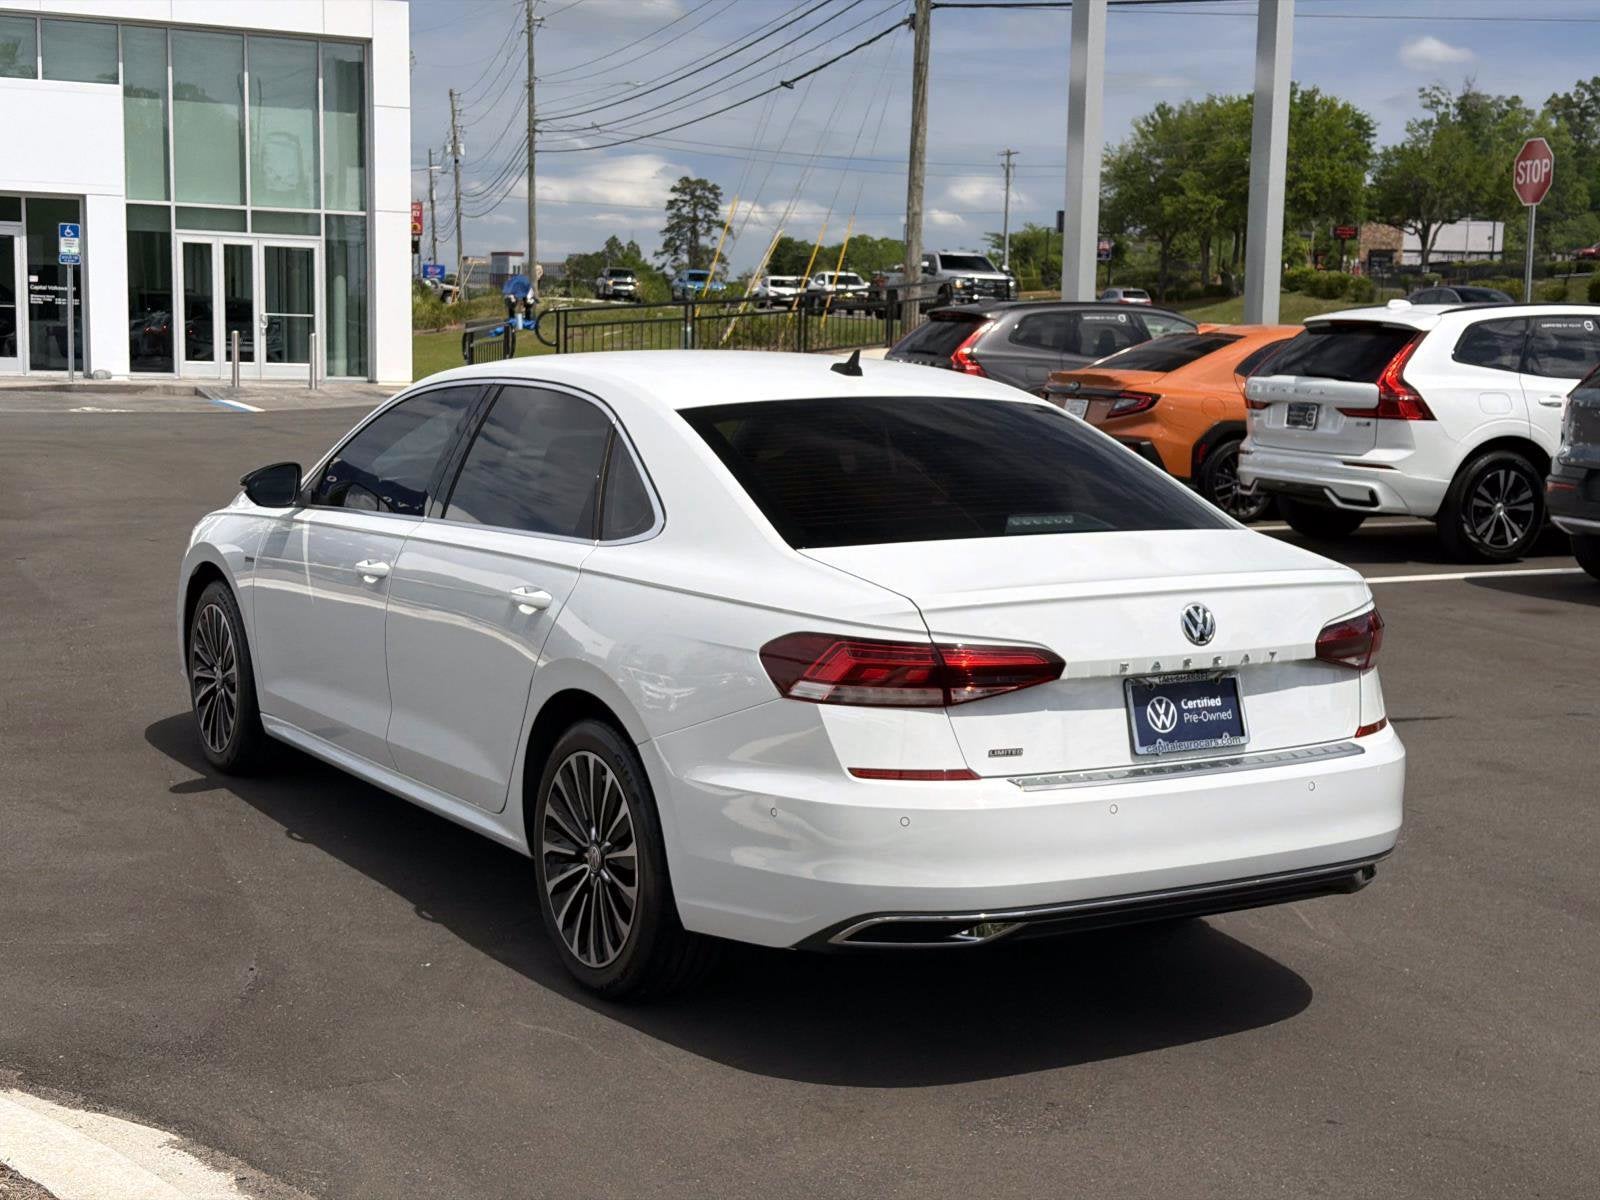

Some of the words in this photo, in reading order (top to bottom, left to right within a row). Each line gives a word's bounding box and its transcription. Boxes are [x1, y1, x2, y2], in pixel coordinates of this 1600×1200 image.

[1517, 158, 1551, 184] STOP
[1181, 696, 1222, 710] Certified
[1183, 708, 1233, 724] Pre-Owned
[988, 748, 1023, 757] LIMITED
[1146, 736, 1242, 754] capitaleurocars.com
